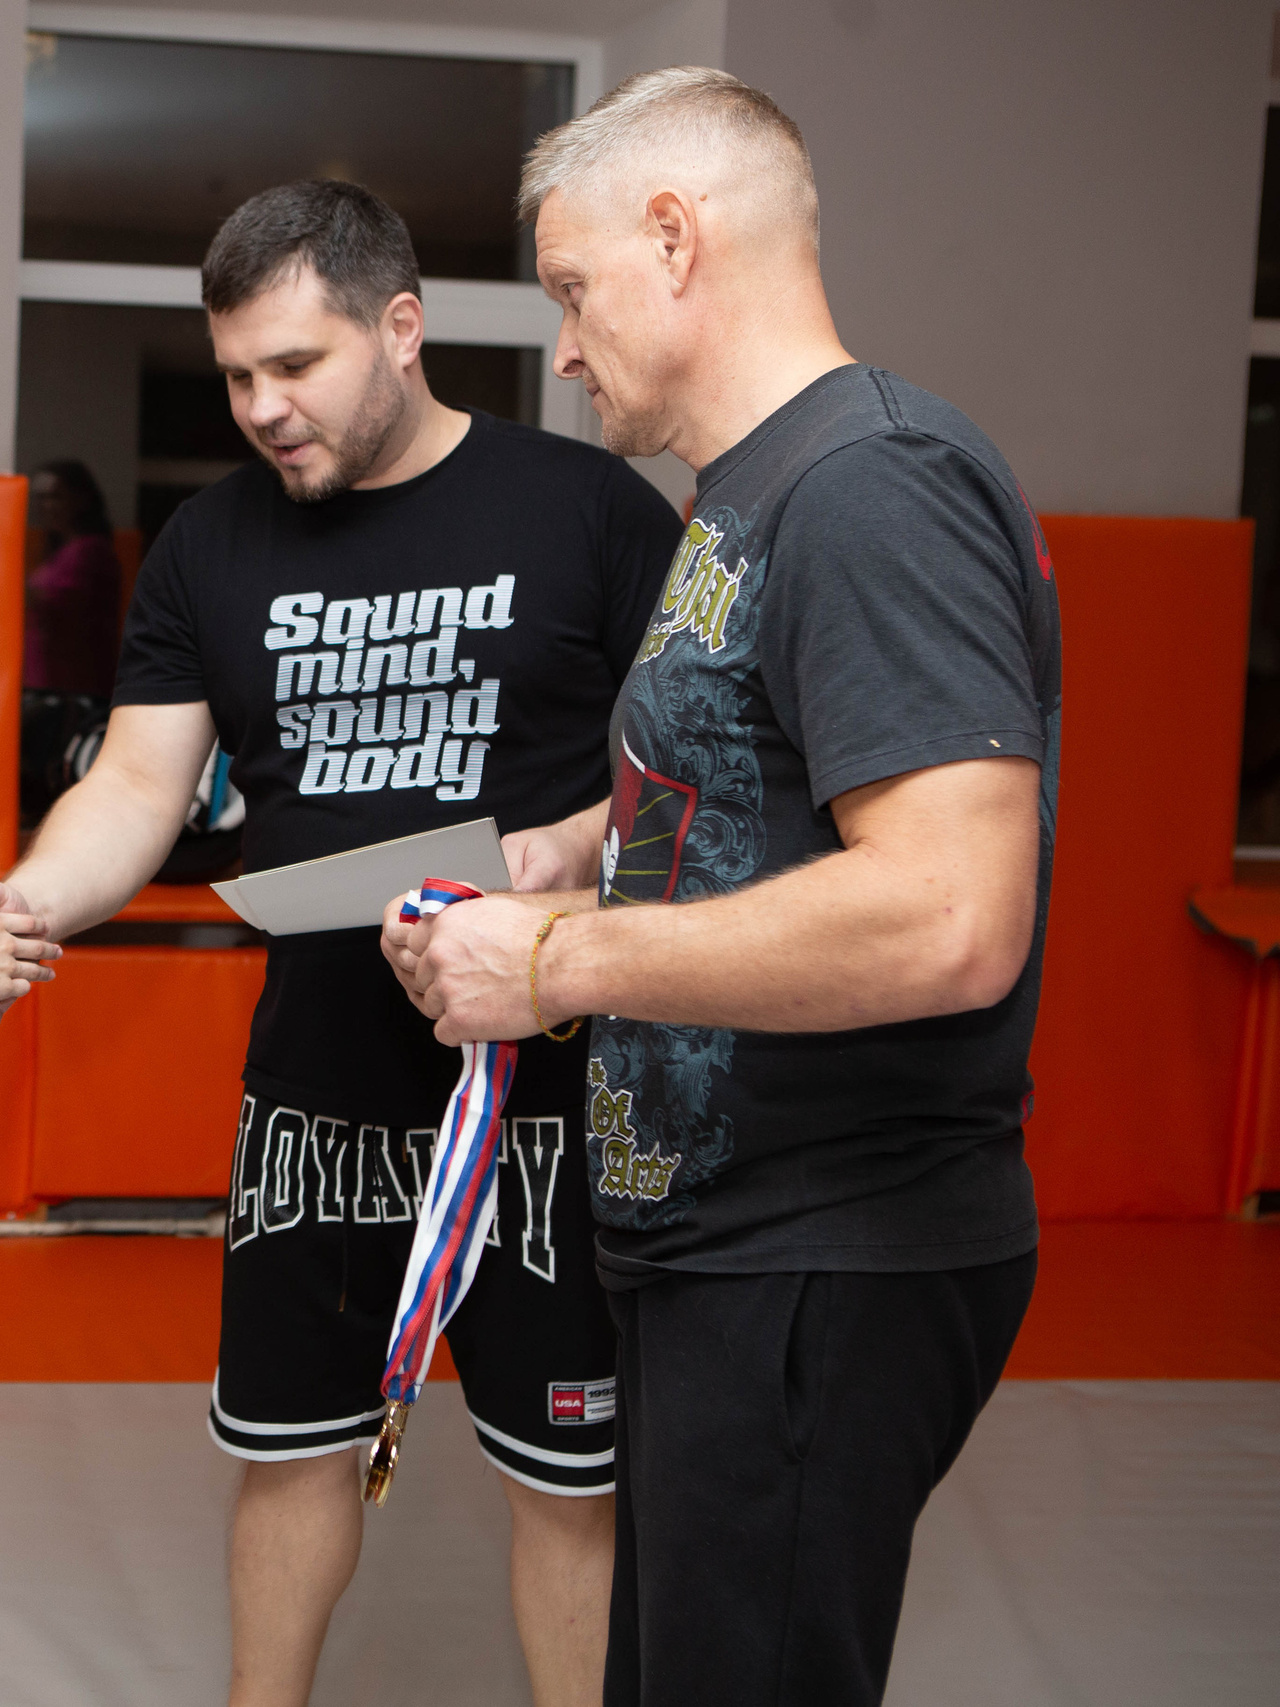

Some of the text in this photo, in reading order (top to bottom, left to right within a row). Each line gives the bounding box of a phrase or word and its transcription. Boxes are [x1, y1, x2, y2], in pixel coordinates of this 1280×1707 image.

[264, 574, 516, 650] Sound
[275, 627, 475, 702] mind,
[276, 678, 500, 749] sound
[298, 732, 491, 801] body
[230, 1094, 564, 1283] LOYAY
[554, 1399, 582, 1408] USA
